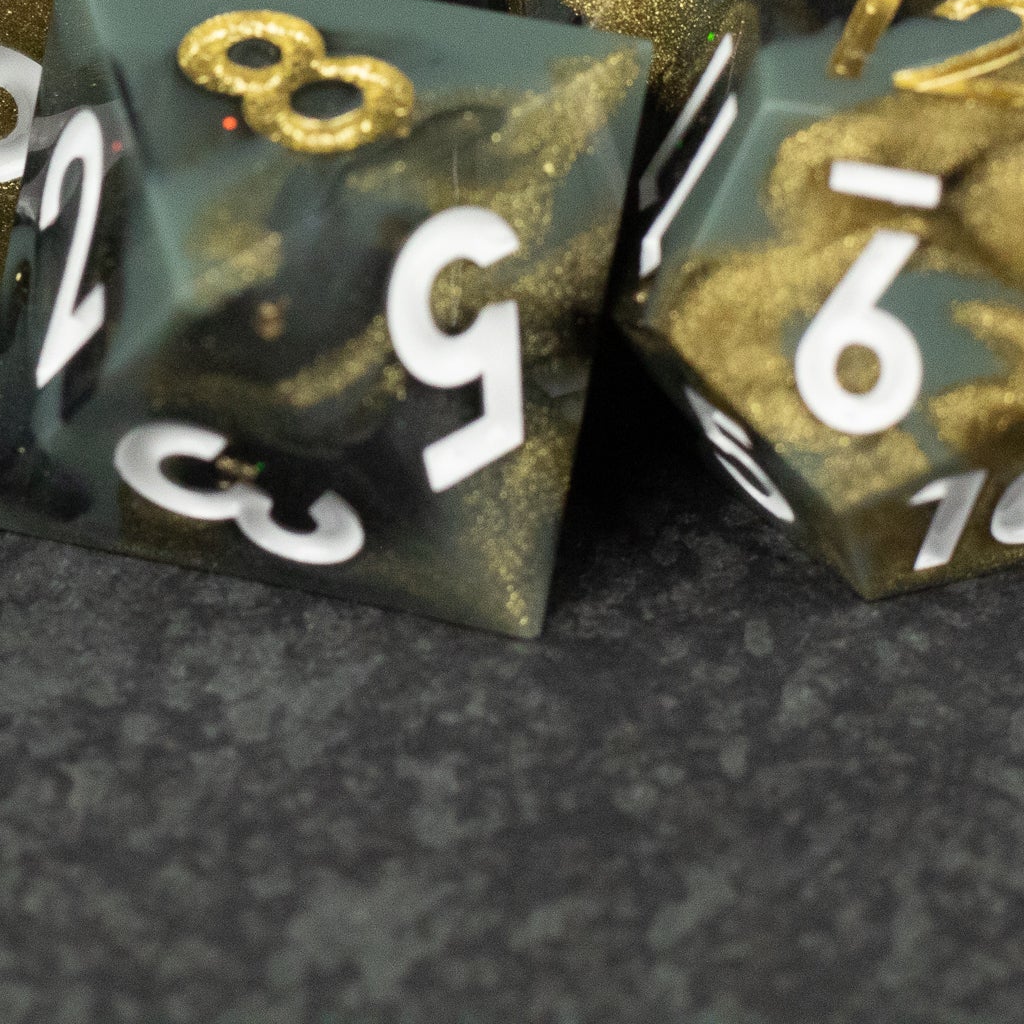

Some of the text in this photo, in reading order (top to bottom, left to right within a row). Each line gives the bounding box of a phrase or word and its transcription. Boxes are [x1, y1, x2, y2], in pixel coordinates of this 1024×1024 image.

[178, 9, 416, 154] 8
[35, 106, 107, 389] 2
[386, 206, 525, 494] 5
[114, 421, 366, 566] 3
